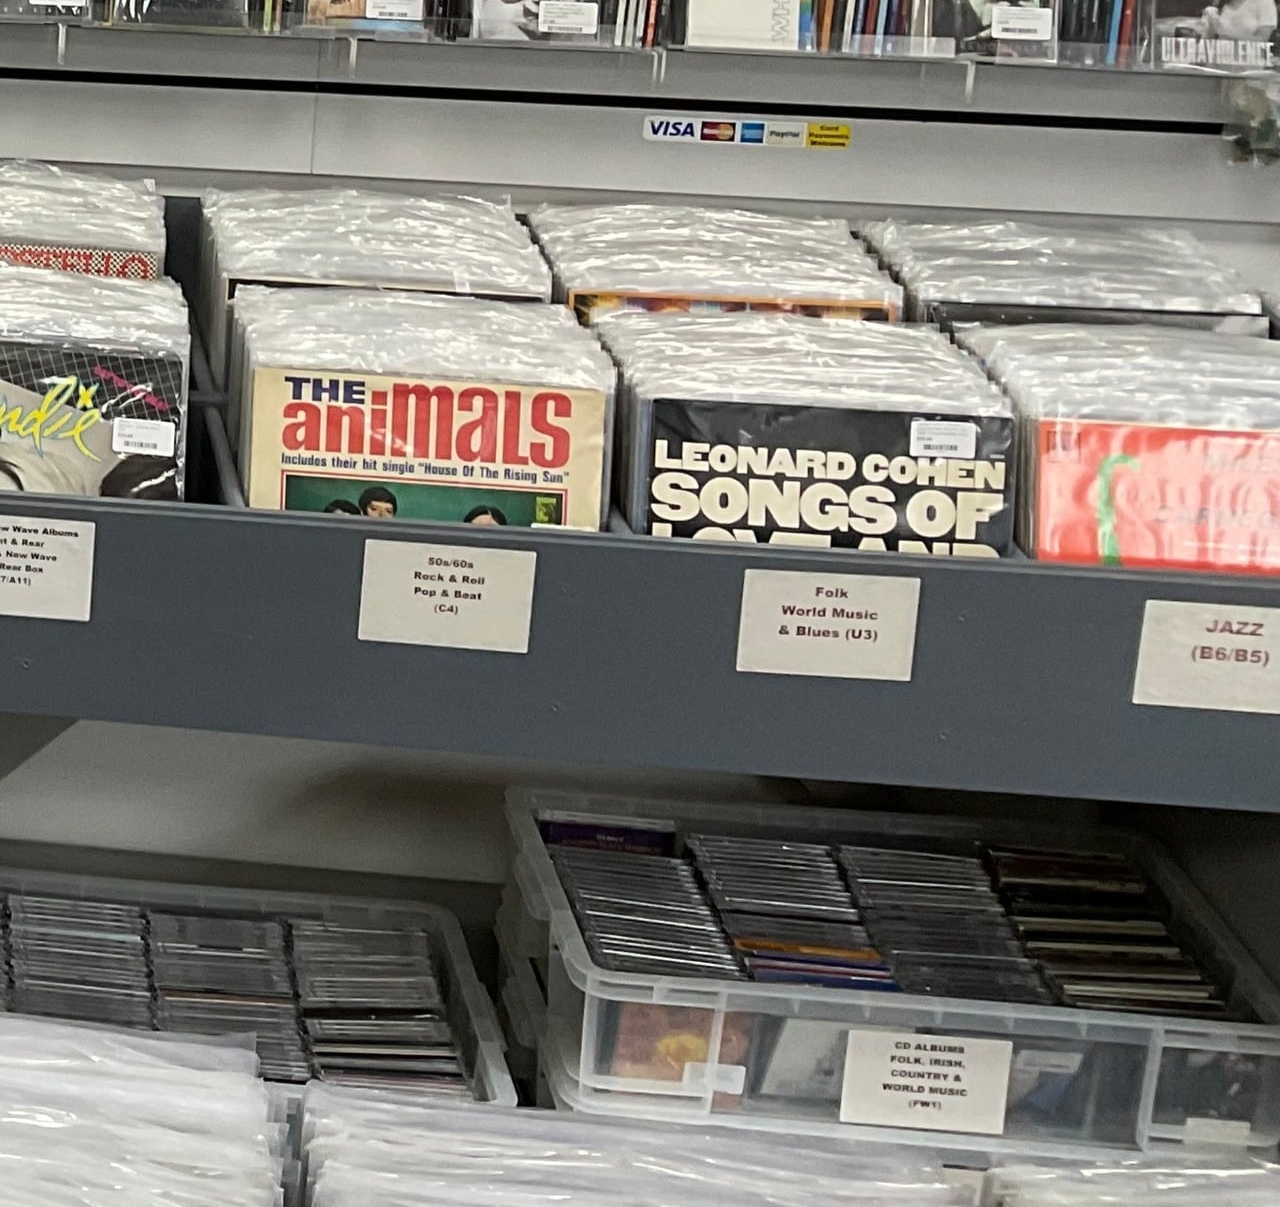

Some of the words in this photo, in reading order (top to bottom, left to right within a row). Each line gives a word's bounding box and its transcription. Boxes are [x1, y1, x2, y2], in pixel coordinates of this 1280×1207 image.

[650, 120, 695, 137] VISA
[284, 376, 366, 404] THE
[281, 383, 572, 469] animals
[281, 452, 328, 467] Includes
[331, 455, 357, 470] their
[362, 457, 378, 471] hit
[382, 459, 415, 475] single
[462, 464, 474, 477] Of
[479, 465, 499, 479] The
[503, 468, 537, 484] Rising
[654, 439, 857, 480] LEONARD
[862, 453, 1006, 490] COHEN
[650, 472, 898, 535] SONGS
[906, 489, 1004, 540] OF
[428, 557, 474, 569] 50s/60s
[413, 571, 445, 582] Rock
[448, 574, 458, 583] &
[461, 575, 486, 586] Roll
[413, 586, 437, 598] Pop
[440, 589, 450, 598] &
[453, 590, 482, 600] Beat
[815, 587, 849, 599] Folk
[433, 604, 459, 615] (C4)
[781, 605, 827, 618] World
[831, 607, 878, 621] Music
[778, 625, 789, 636] &
[796, 626, 840, 639] Blues
[844, 628, 878, 642] (U3)
[1205, 619, 1265, 637] JAZZ
[1191, 645, 1270, 667] (B6/B5)
[894, 1041, 912, 1050] CD
[914, 1043, 966, 1055] ALBUMS
[890, 1055, 925, 1067] FOLK,
[890, 1069, 949, 1081] COUNTRY
[953, 1073, 962, 1083] &
[882, 1083, 926, 1094] WORLD
[928, 1086, 968, 1097] MUSIC
